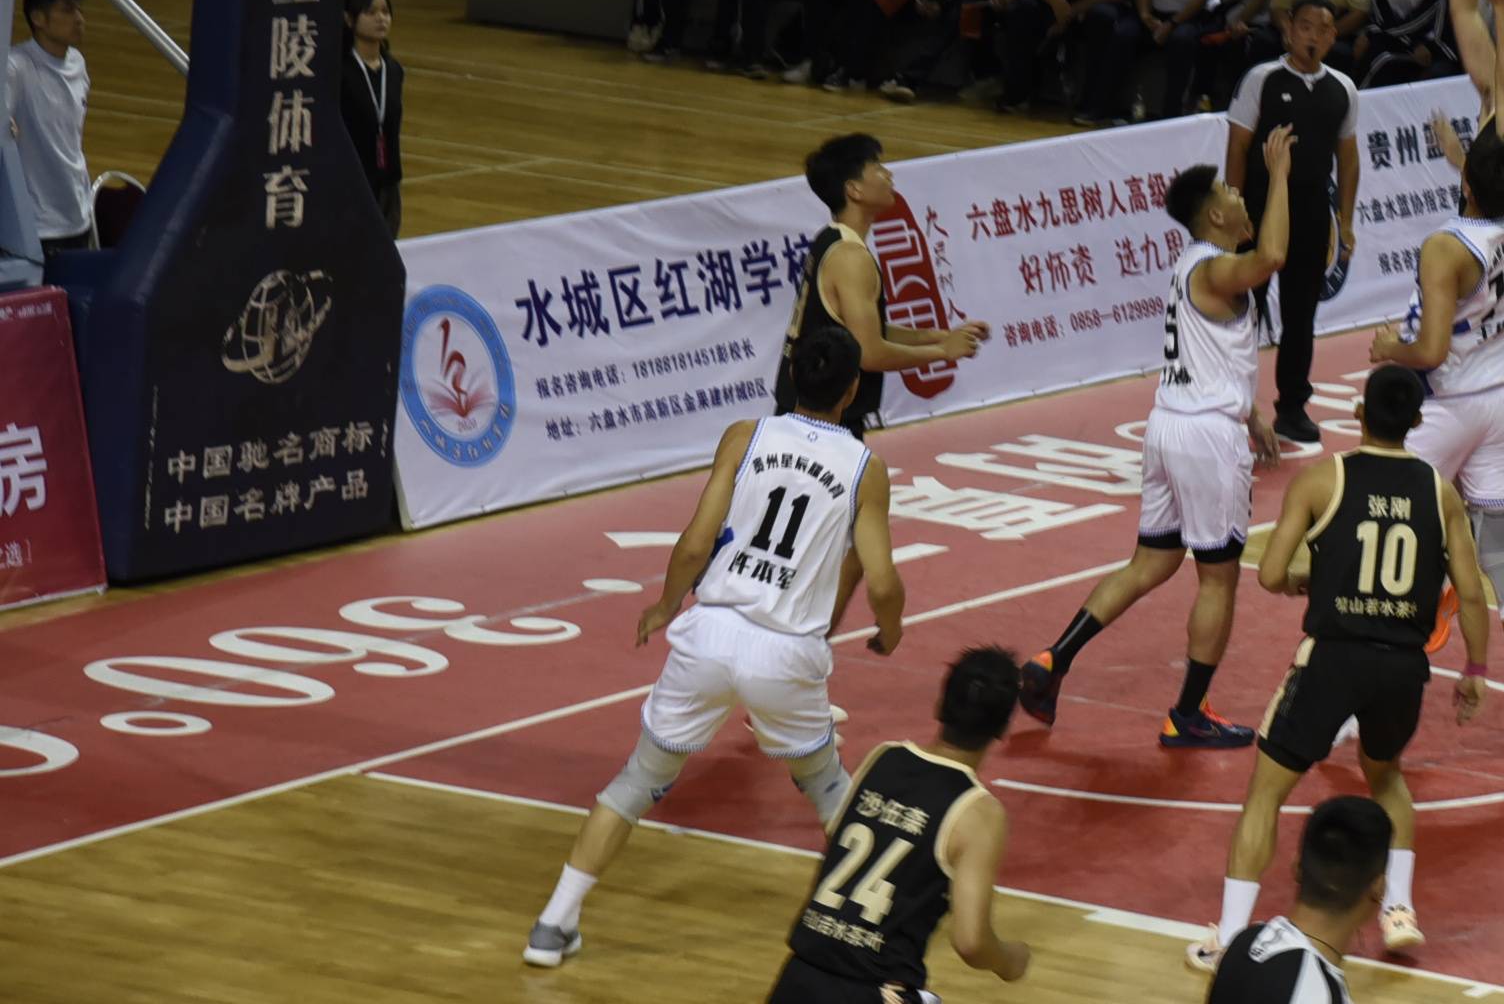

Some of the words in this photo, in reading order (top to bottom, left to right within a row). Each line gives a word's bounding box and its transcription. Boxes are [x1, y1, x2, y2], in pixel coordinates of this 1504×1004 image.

[1018, 245, 1098, 295] 好师资
[166, 421, 375, 484] 中国驰名商标
[163, 467, 370, 534] 中国名牌产品
[750, 485, 811, 560] 11
[1355, 519, 1419, 597] 10
[813, 821, 916, 926] 24
